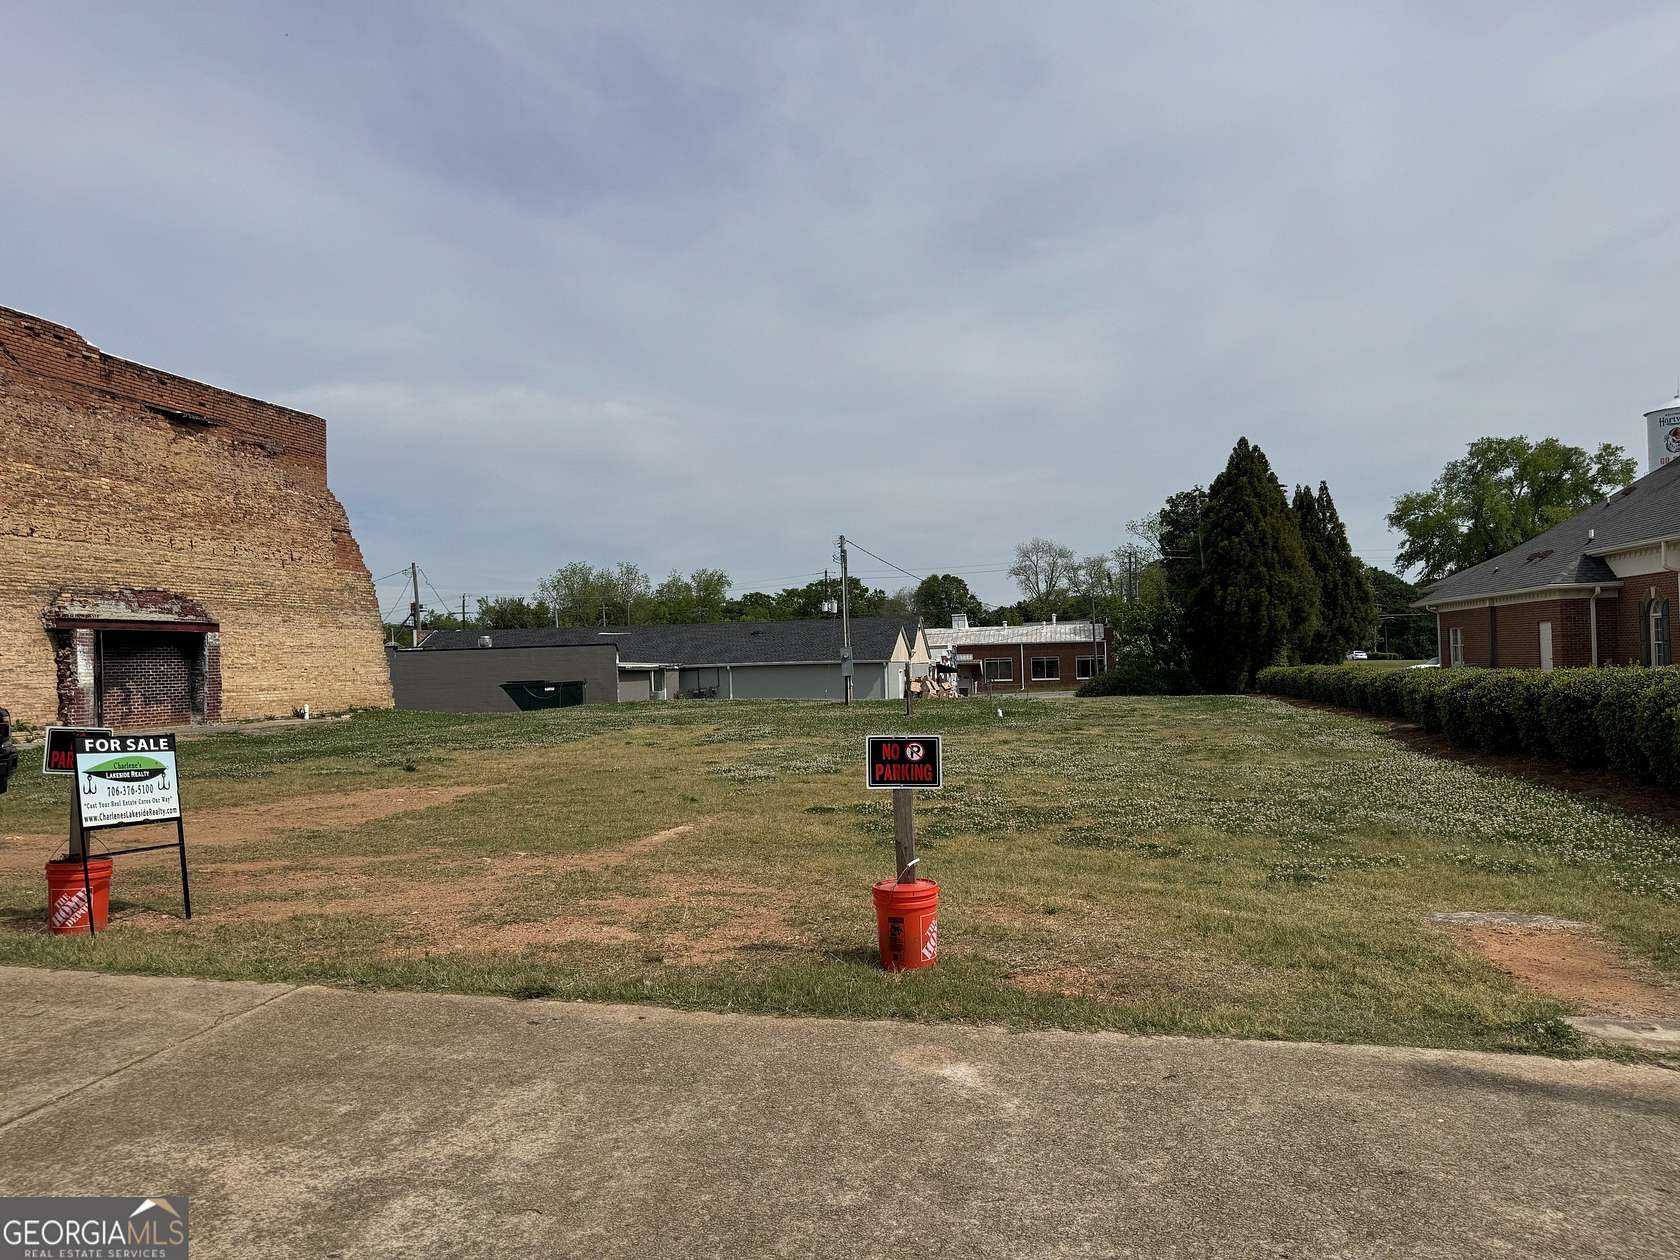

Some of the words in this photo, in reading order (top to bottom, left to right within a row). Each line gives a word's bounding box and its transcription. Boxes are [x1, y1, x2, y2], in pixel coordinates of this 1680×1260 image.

[84, 739, 121, 752] FOR
[126, 738, 169, 752] SALE
[882, 743, 900, 760] NO
[51, 751, 75, 769] PAR
[113, 761, 142, 770] Charlene's
[131, 770, 150, 778] REALTY
[875, 763, 933, 781] PARKING
[107, 783, 154, 798] 706-376-5100
[122, 799, 137, 807] Estate
[83, 806, 178, 823] www.CharlenesLakesideRealty.com
